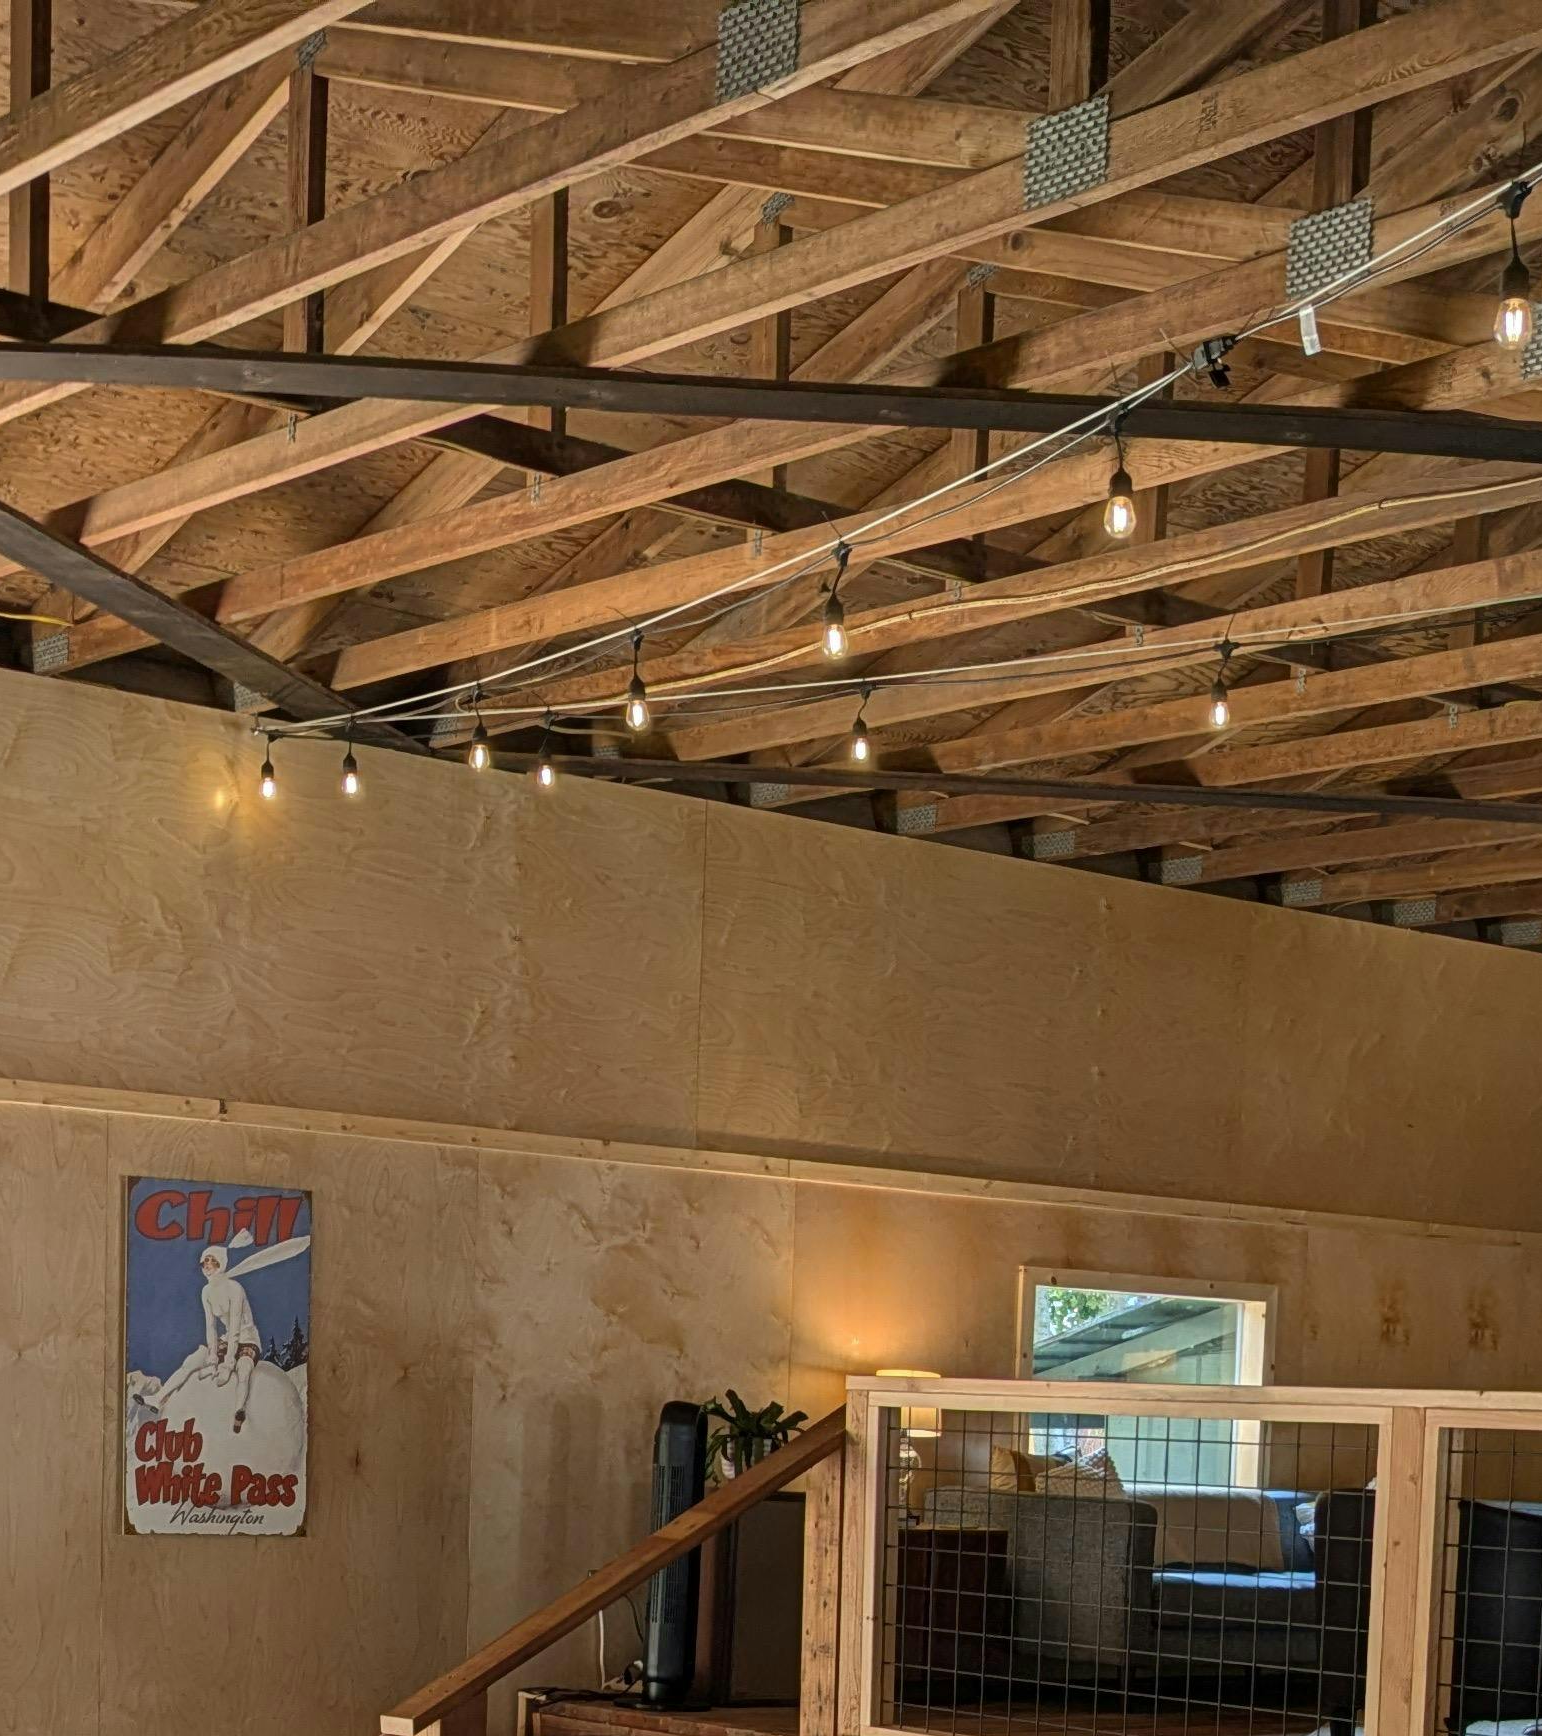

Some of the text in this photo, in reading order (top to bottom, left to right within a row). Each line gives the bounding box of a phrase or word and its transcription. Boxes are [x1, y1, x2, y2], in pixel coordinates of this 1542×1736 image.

[134, 1189, 303, 1247] Chill
[134, 1418, 204, 1463] Club
[134, 1461, 299, 1508] White Pass
[169, 1501, 265, 1535] Washington
